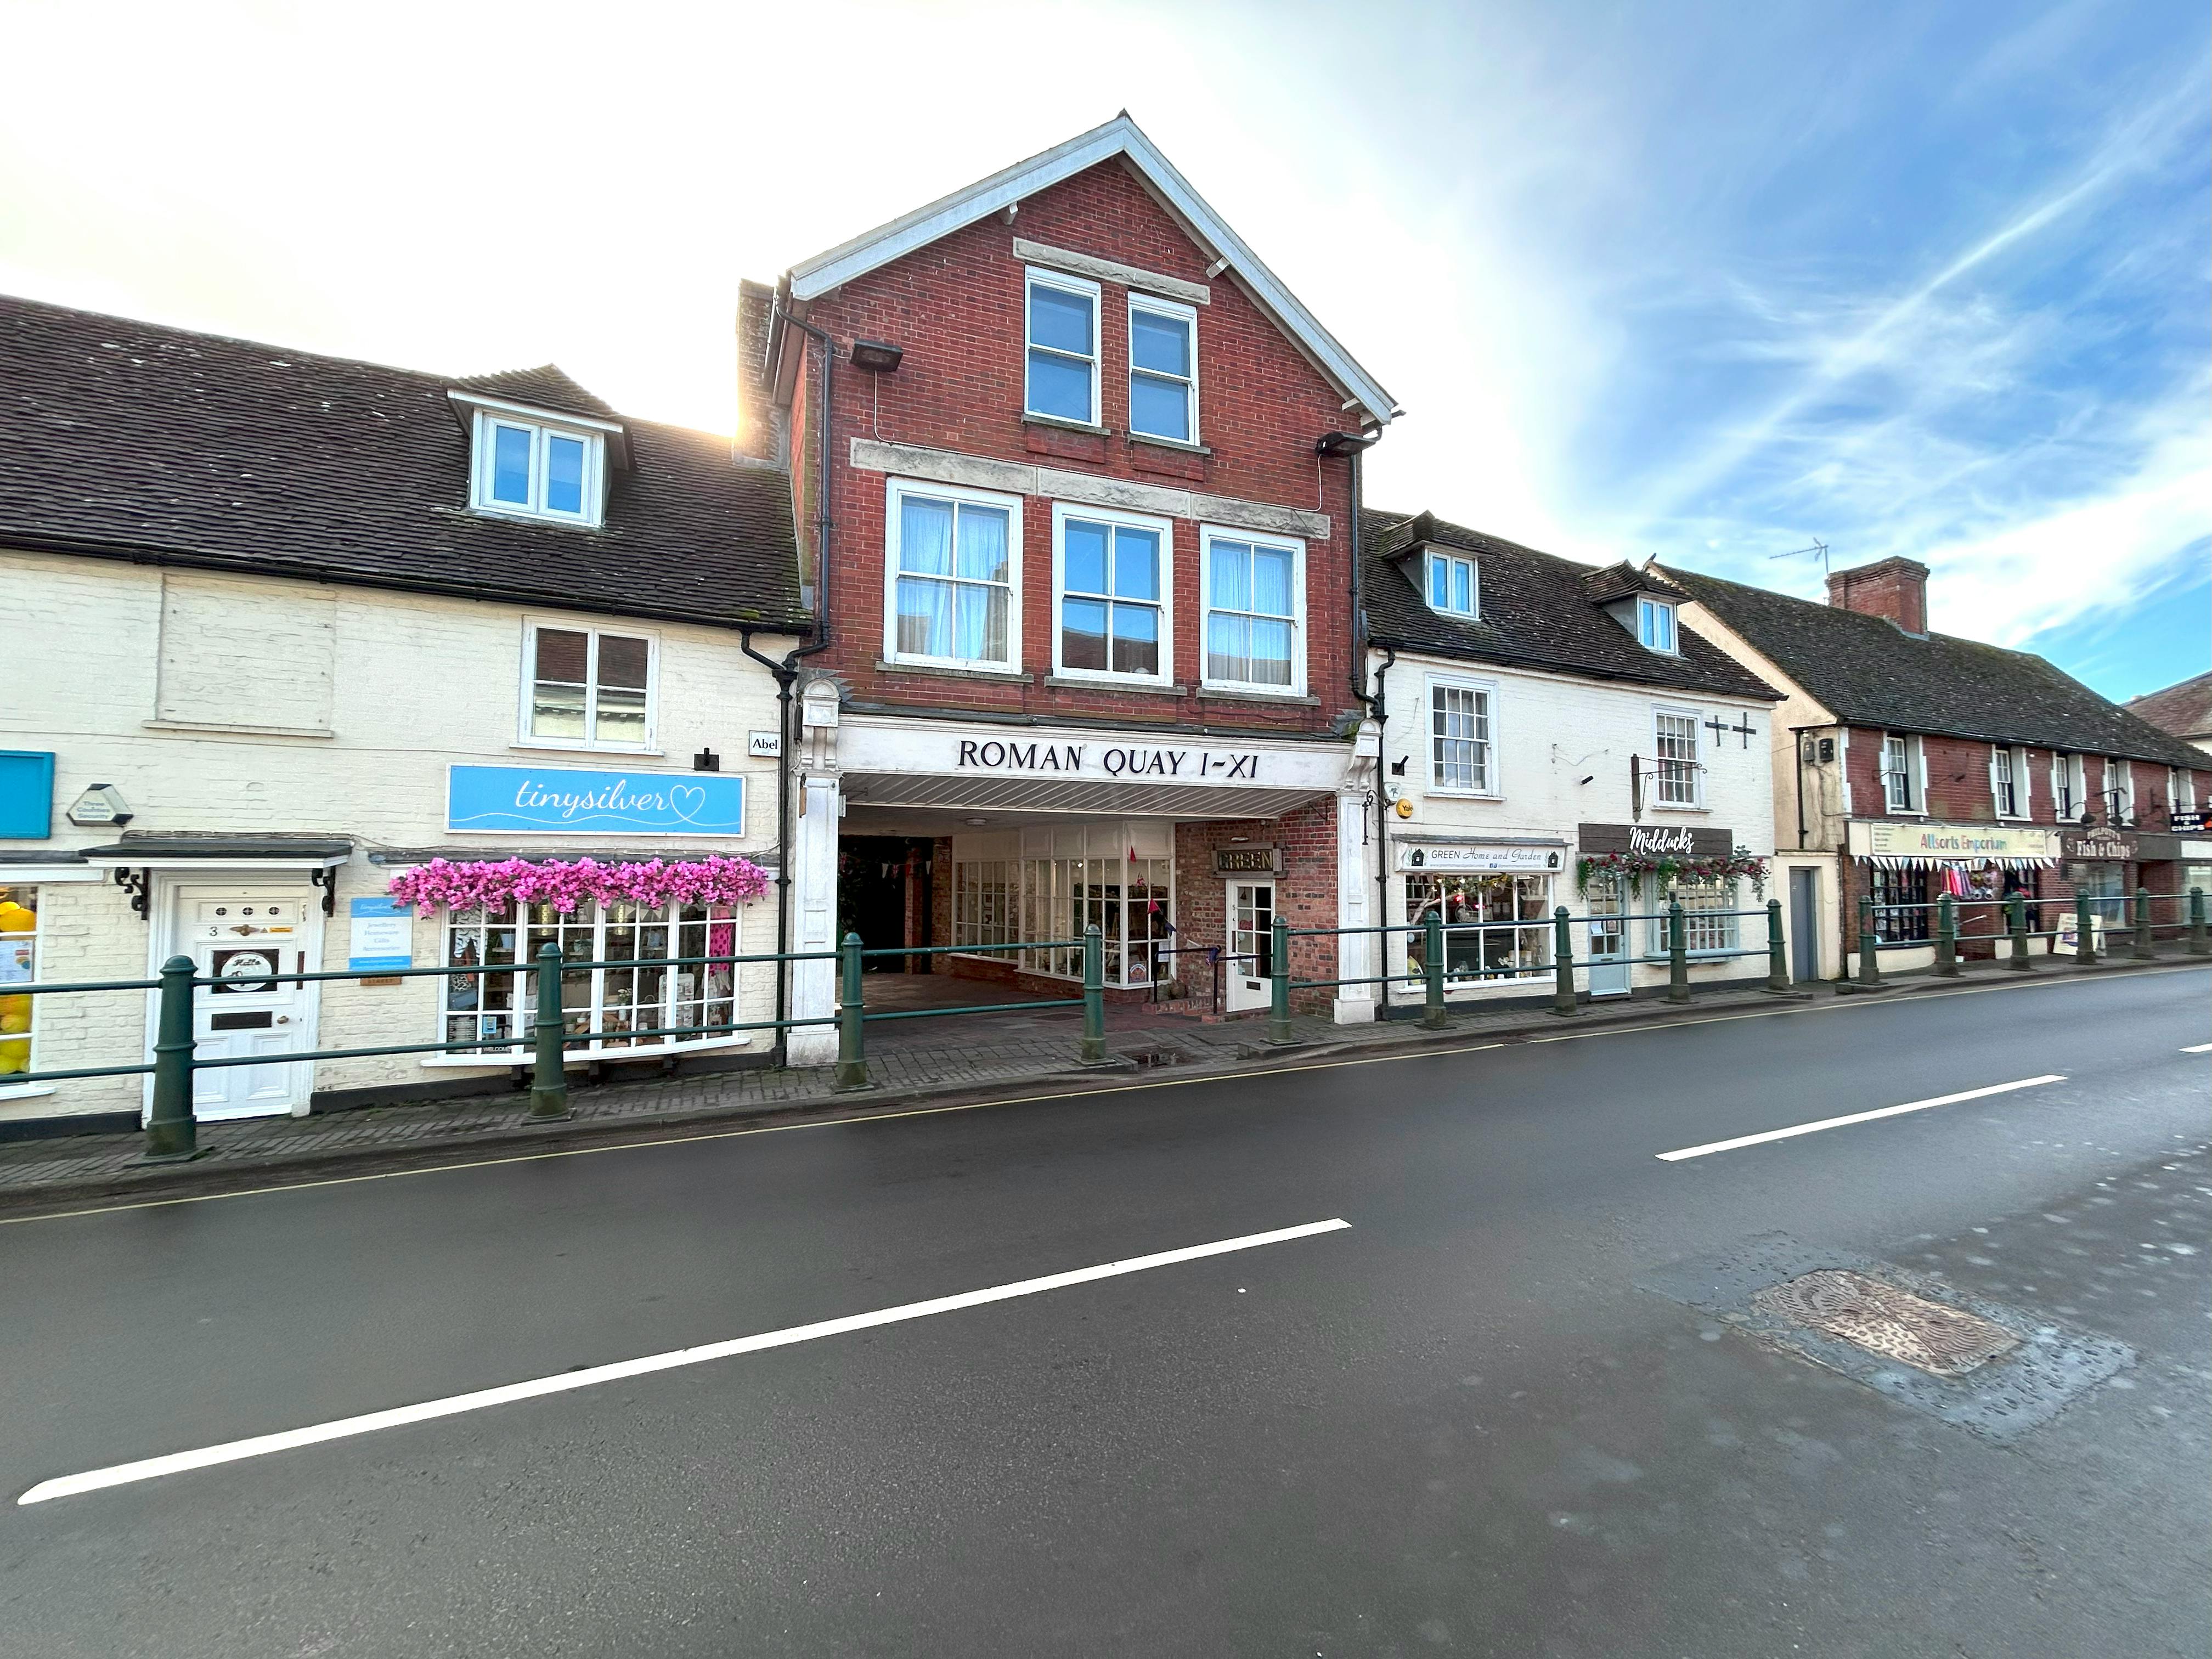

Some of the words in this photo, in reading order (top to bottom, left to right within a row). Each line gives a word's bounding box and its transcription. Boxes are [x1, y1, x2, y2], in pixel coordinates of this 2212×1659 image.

[753, 738, 778, 749] Abel
[957, 740, 1082, 771] ROMAN
[1103, 749, 1186, 777] QUAY
[515, 778, 669, 818] tinysilver
[1921, 833, 1959, 850] Allsorts
[1961, 834, 2007, 854] Emporium
[2076, 840, 2096, 856] Fish
[2107, 841, 2130, 860] Chips
[1218, 851, 1272, 869] GREEN
[1431, 850, 1460, 859] GREEN
[1463, 847, 1489, 860] Home
[1493, 849, 1509, 860] and
[1511, 848, 1542, 862] Garden
[209, 926, 218, 936] 3
